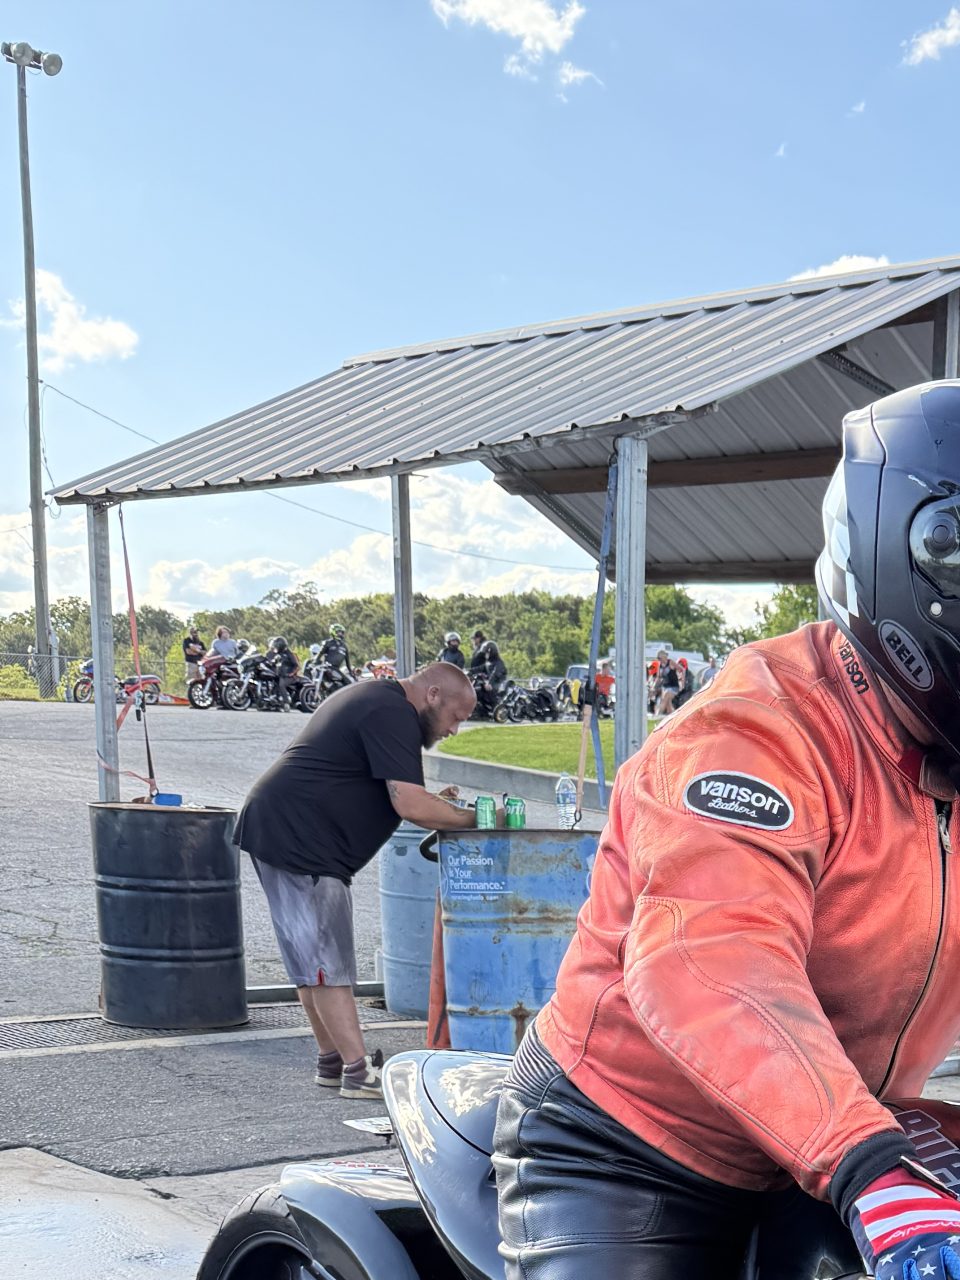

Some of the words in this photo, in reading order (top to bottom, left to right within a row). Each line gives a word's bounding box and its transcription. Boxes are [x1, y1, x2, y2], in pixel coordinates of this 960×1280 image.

[885, 630, 924, 683] BELL
[700, 780, 782, 814] vanson
[708, 797, 758, 818] Leathers
[448, 855, 460, 866] Our
[460, 855, 494, 866] Passion
[454, 867, 472, 879] Your
